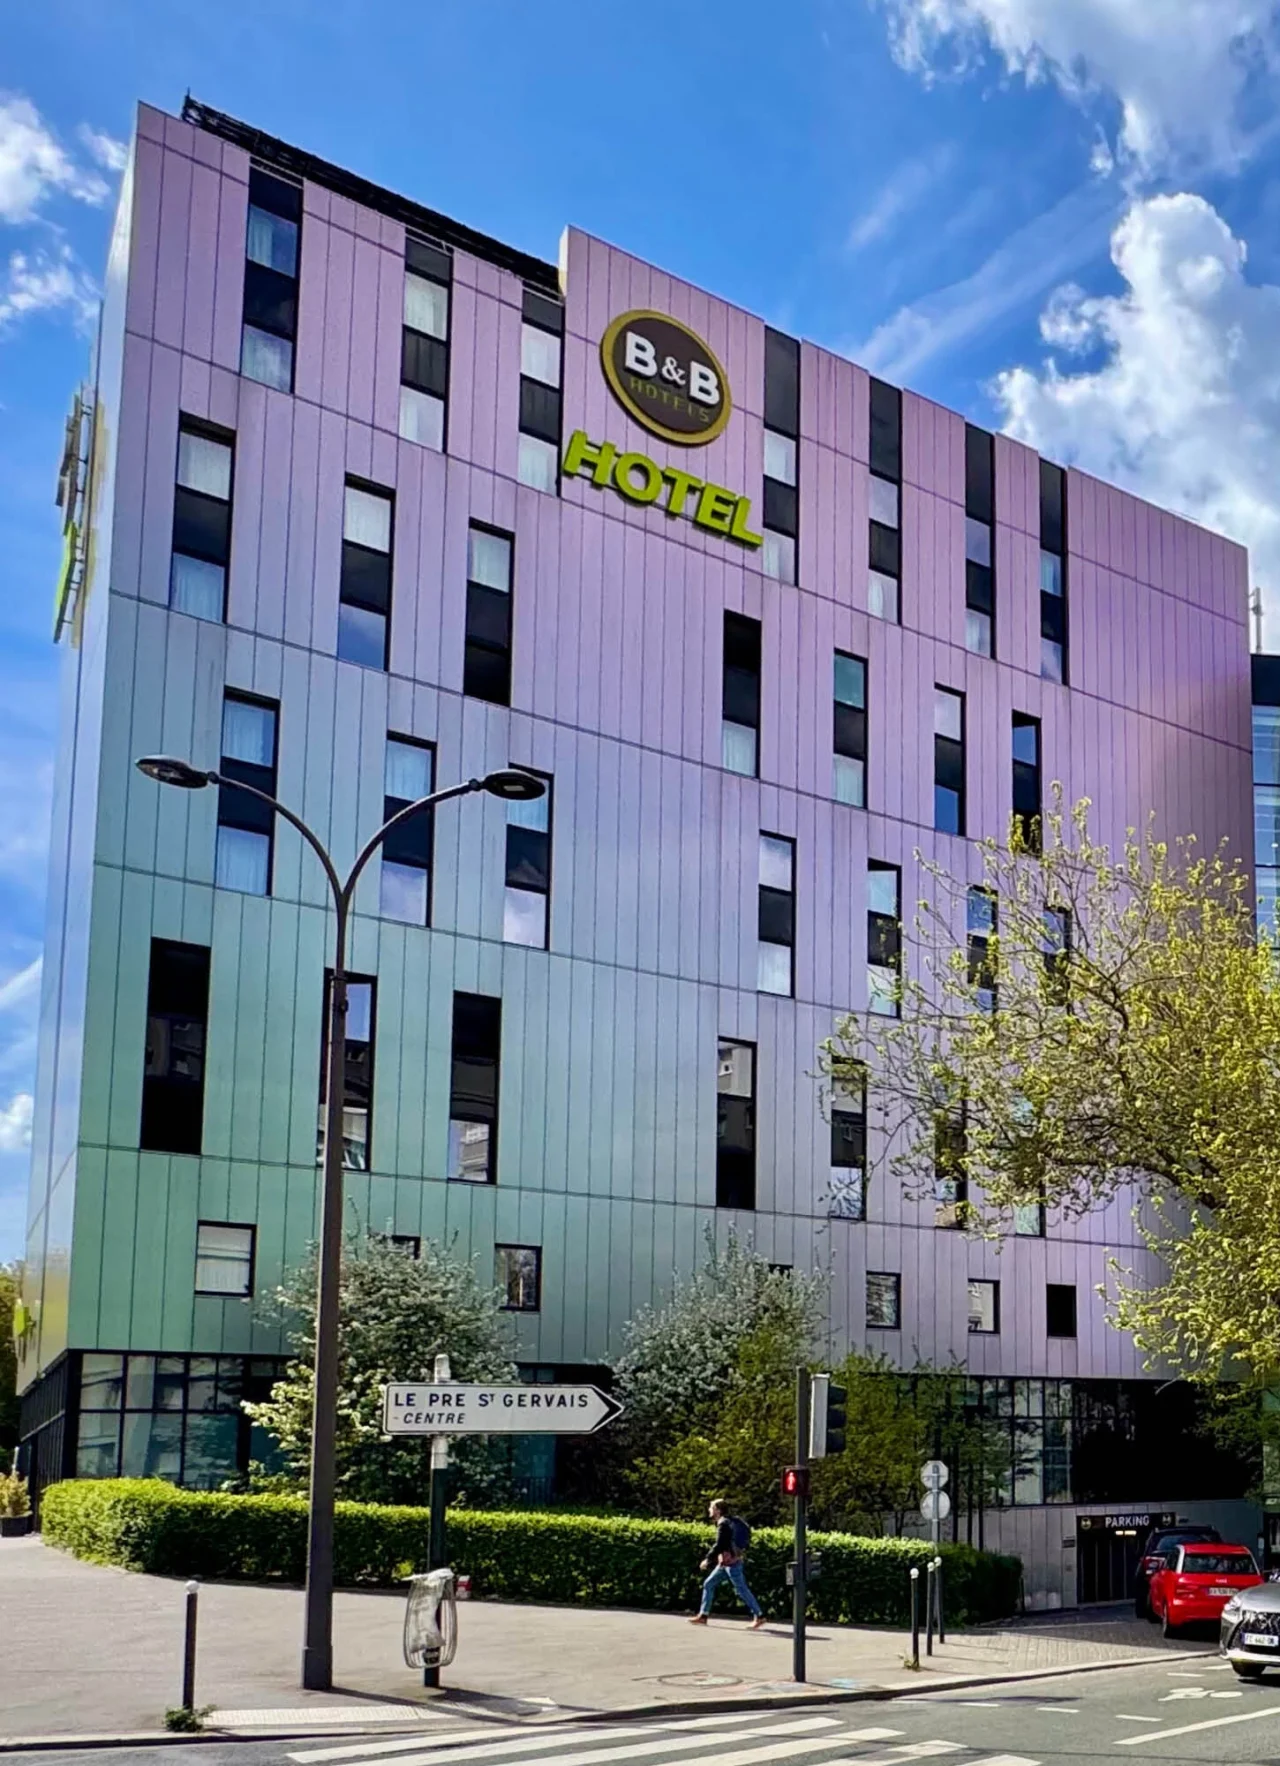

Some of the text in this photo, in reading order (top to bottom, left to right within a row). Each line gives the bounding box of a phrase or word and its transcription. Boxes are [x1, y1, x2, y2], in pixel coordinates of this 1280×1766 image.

[625, 331, 721, 406] B&B
[563, 429, 764, 546] HOTEL
[394, 1392, 417, 1407] LE
[428, 1392, 466, 1407] PRE
[503, 1393, 588, 1408] GERVAIS
[403, 1412, 466, 1424] CENTRE
[1104, 1515, 1150, 1529] PARKING
